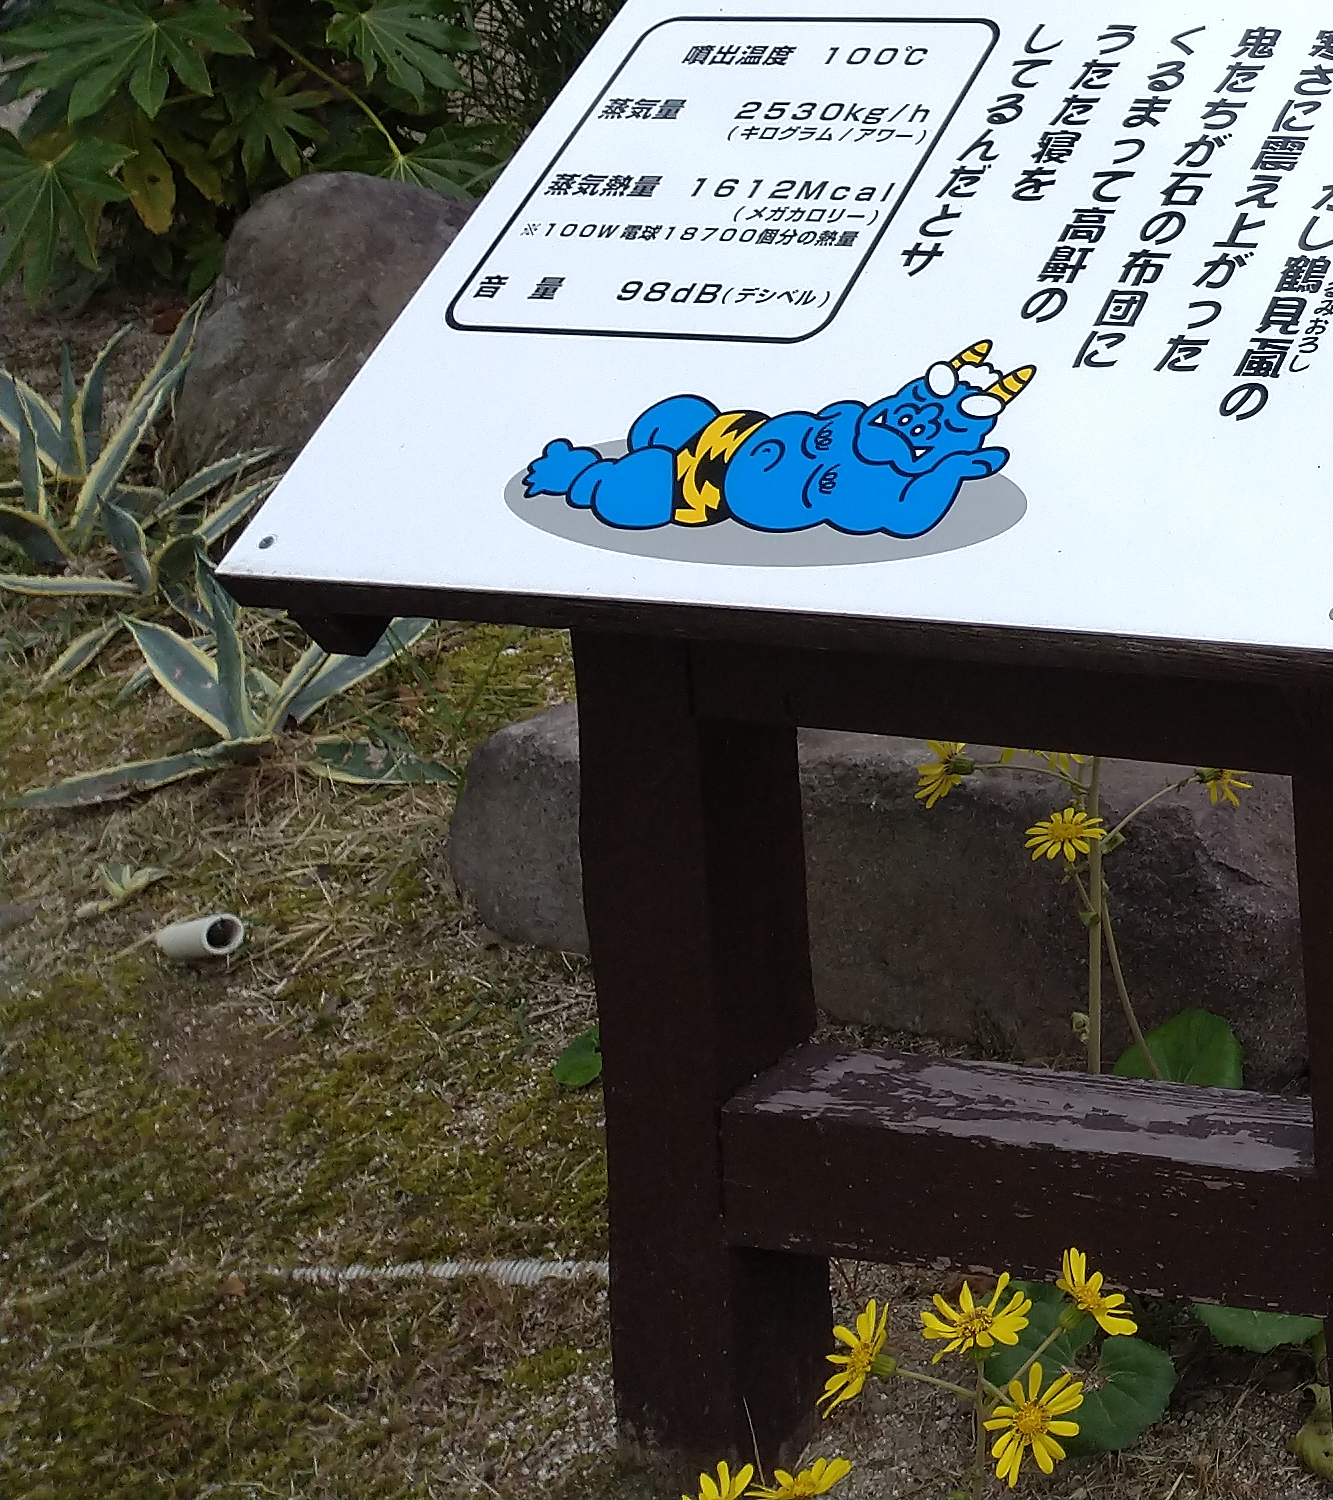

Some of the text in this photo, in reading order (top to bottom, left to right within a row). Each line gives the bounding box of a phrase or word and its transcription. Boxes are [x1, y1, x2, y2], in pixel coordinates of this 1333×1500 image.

[598, 98, 932, 124] 蒸気量 2530kg/h
[681, 44, 930, 67] 噴出温度 100℃
[1011, 24, 1138, 201] うたた寝を
[543, 174, 899, 203] 蒸気熱量 1612Mcal
[900, 23, 1063, 277] してるんだとサ
[1021, 25, 1206, 323] くるまって高鼾の
[1072, 26, 1281, 368] 鬼たちが石の布団に
